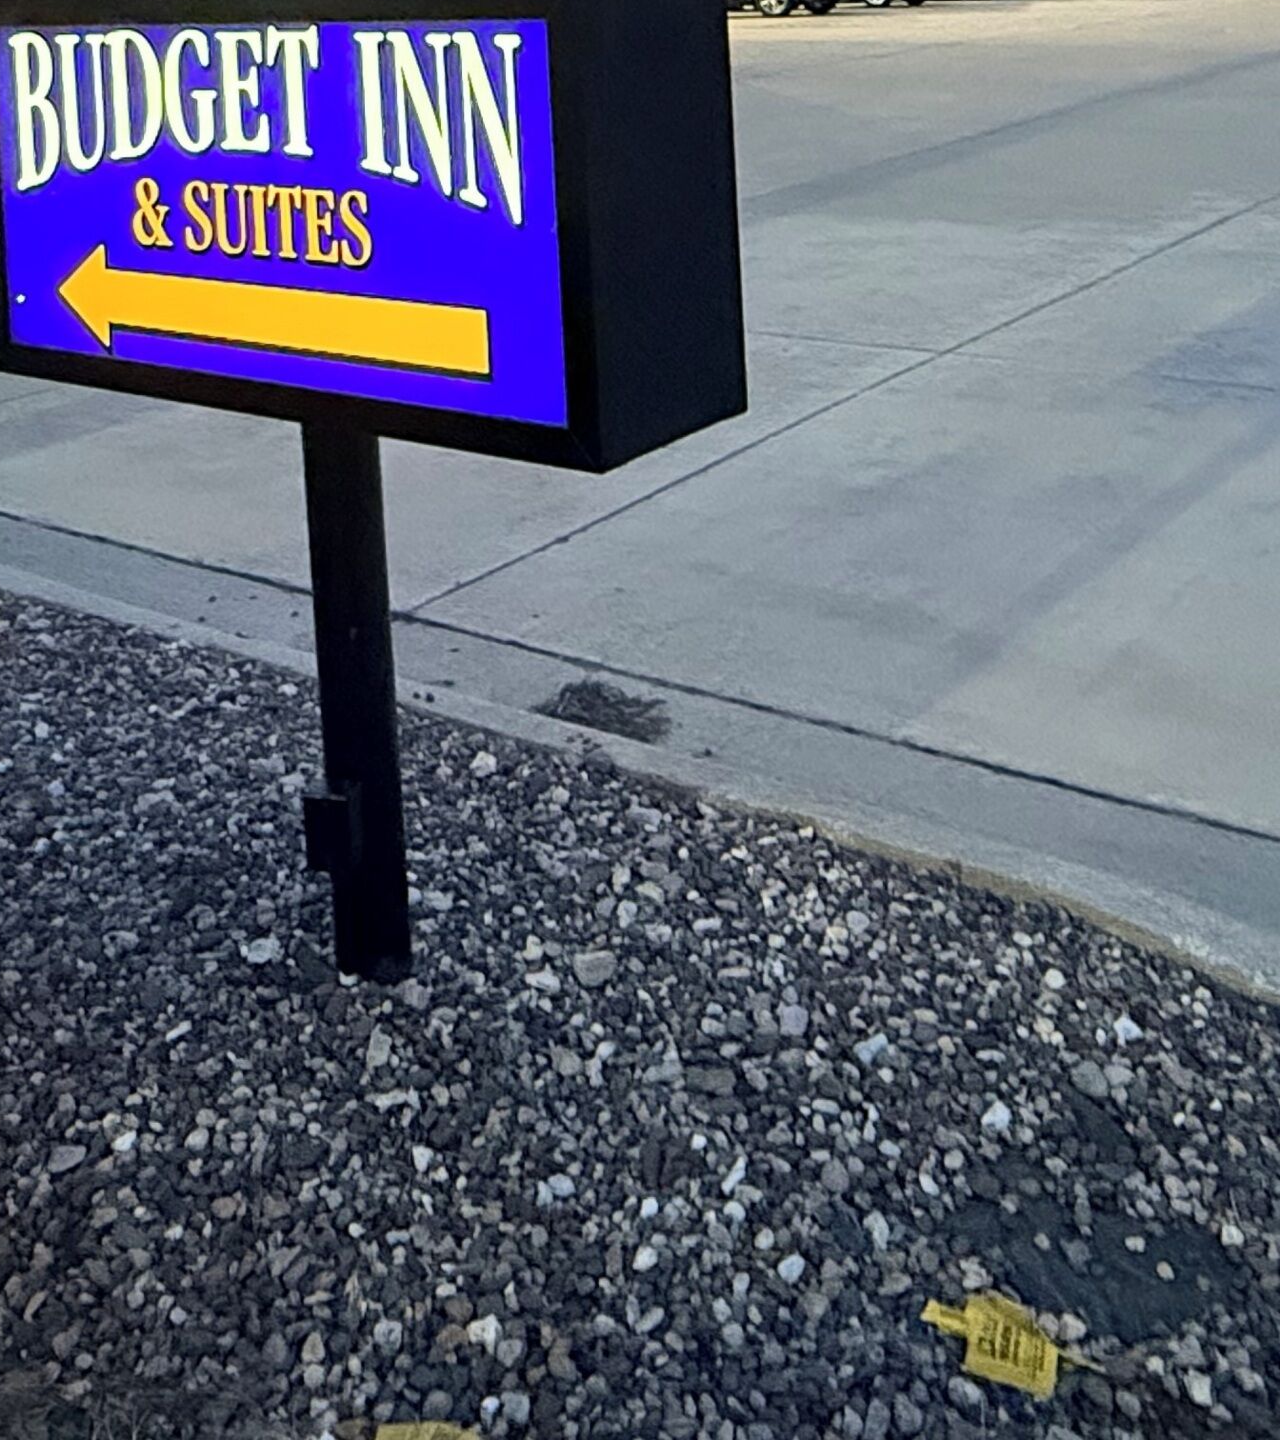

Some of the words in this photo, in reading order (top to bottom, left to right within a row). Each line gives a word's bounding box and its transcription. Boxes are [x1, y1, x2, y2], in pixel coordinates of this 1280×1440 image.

[8, 24, 320, 192] BUDGET
[352, 30, 523, 226] INN
[131, 176, 174, 248] &
[183, 179, 374, 267] SUITES
